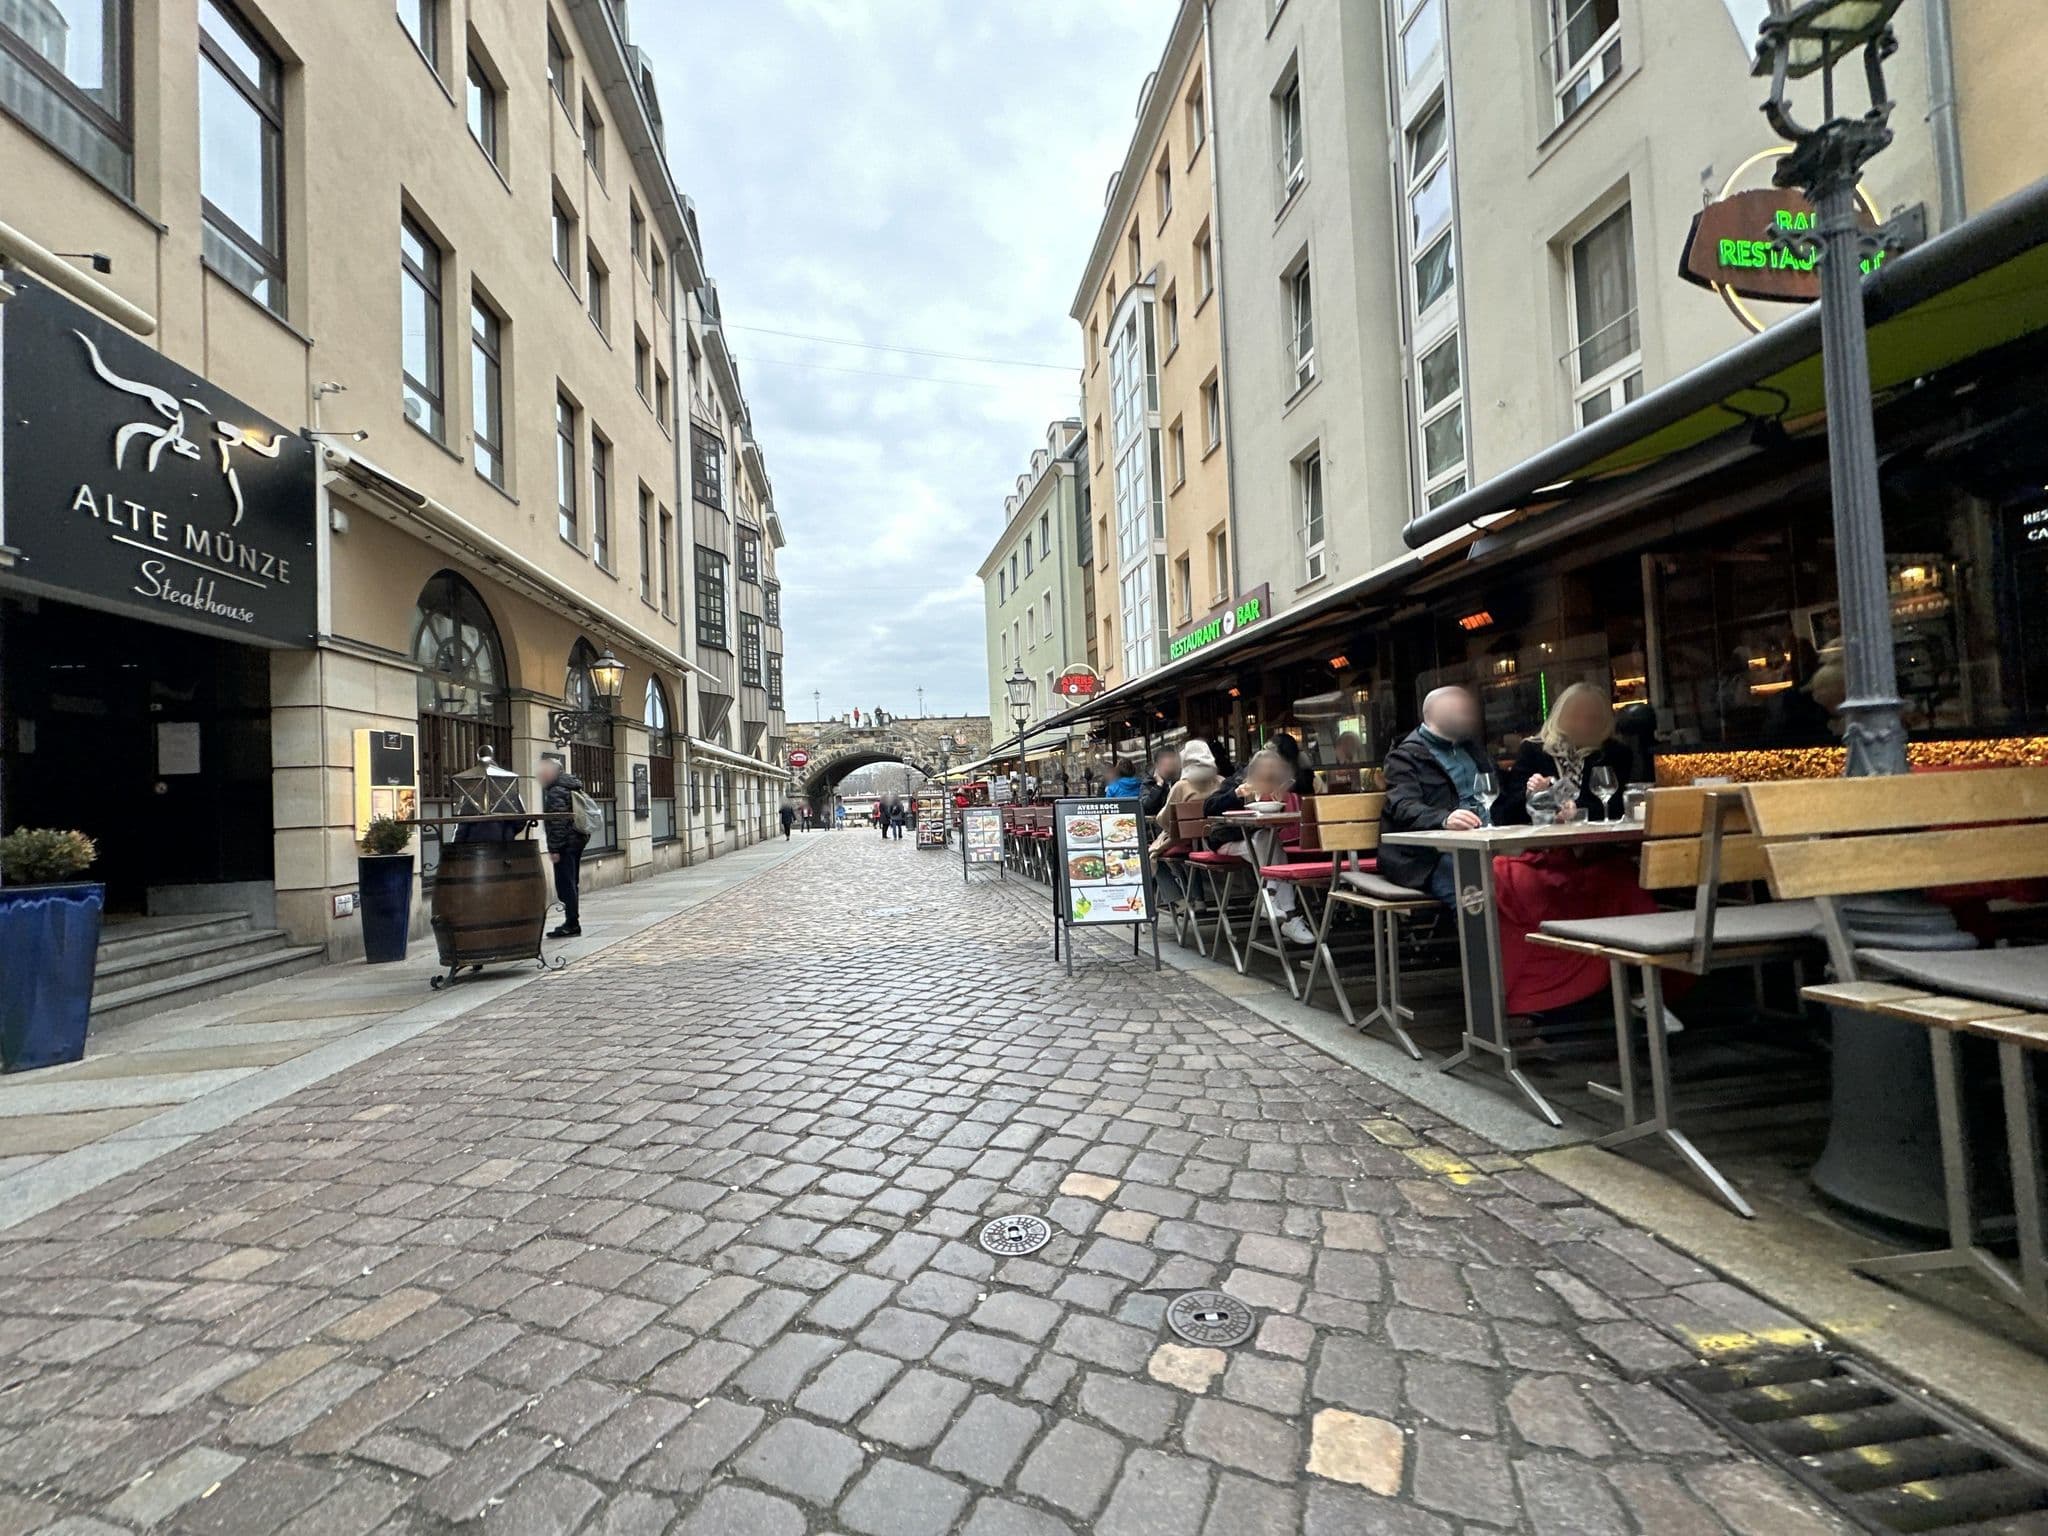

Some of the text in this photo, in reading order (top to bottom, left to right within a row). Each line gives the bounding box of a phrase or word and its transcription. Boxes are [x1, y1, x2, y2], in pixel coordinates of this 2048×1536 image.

[1776, 210, 1816, 231] BA
[72, 484, 291, 584] ALTE MÜNZE
[134, 560, 256, 623] Steakhouse
[1170, 599, 1260, 660] RESTAURANT BAR
